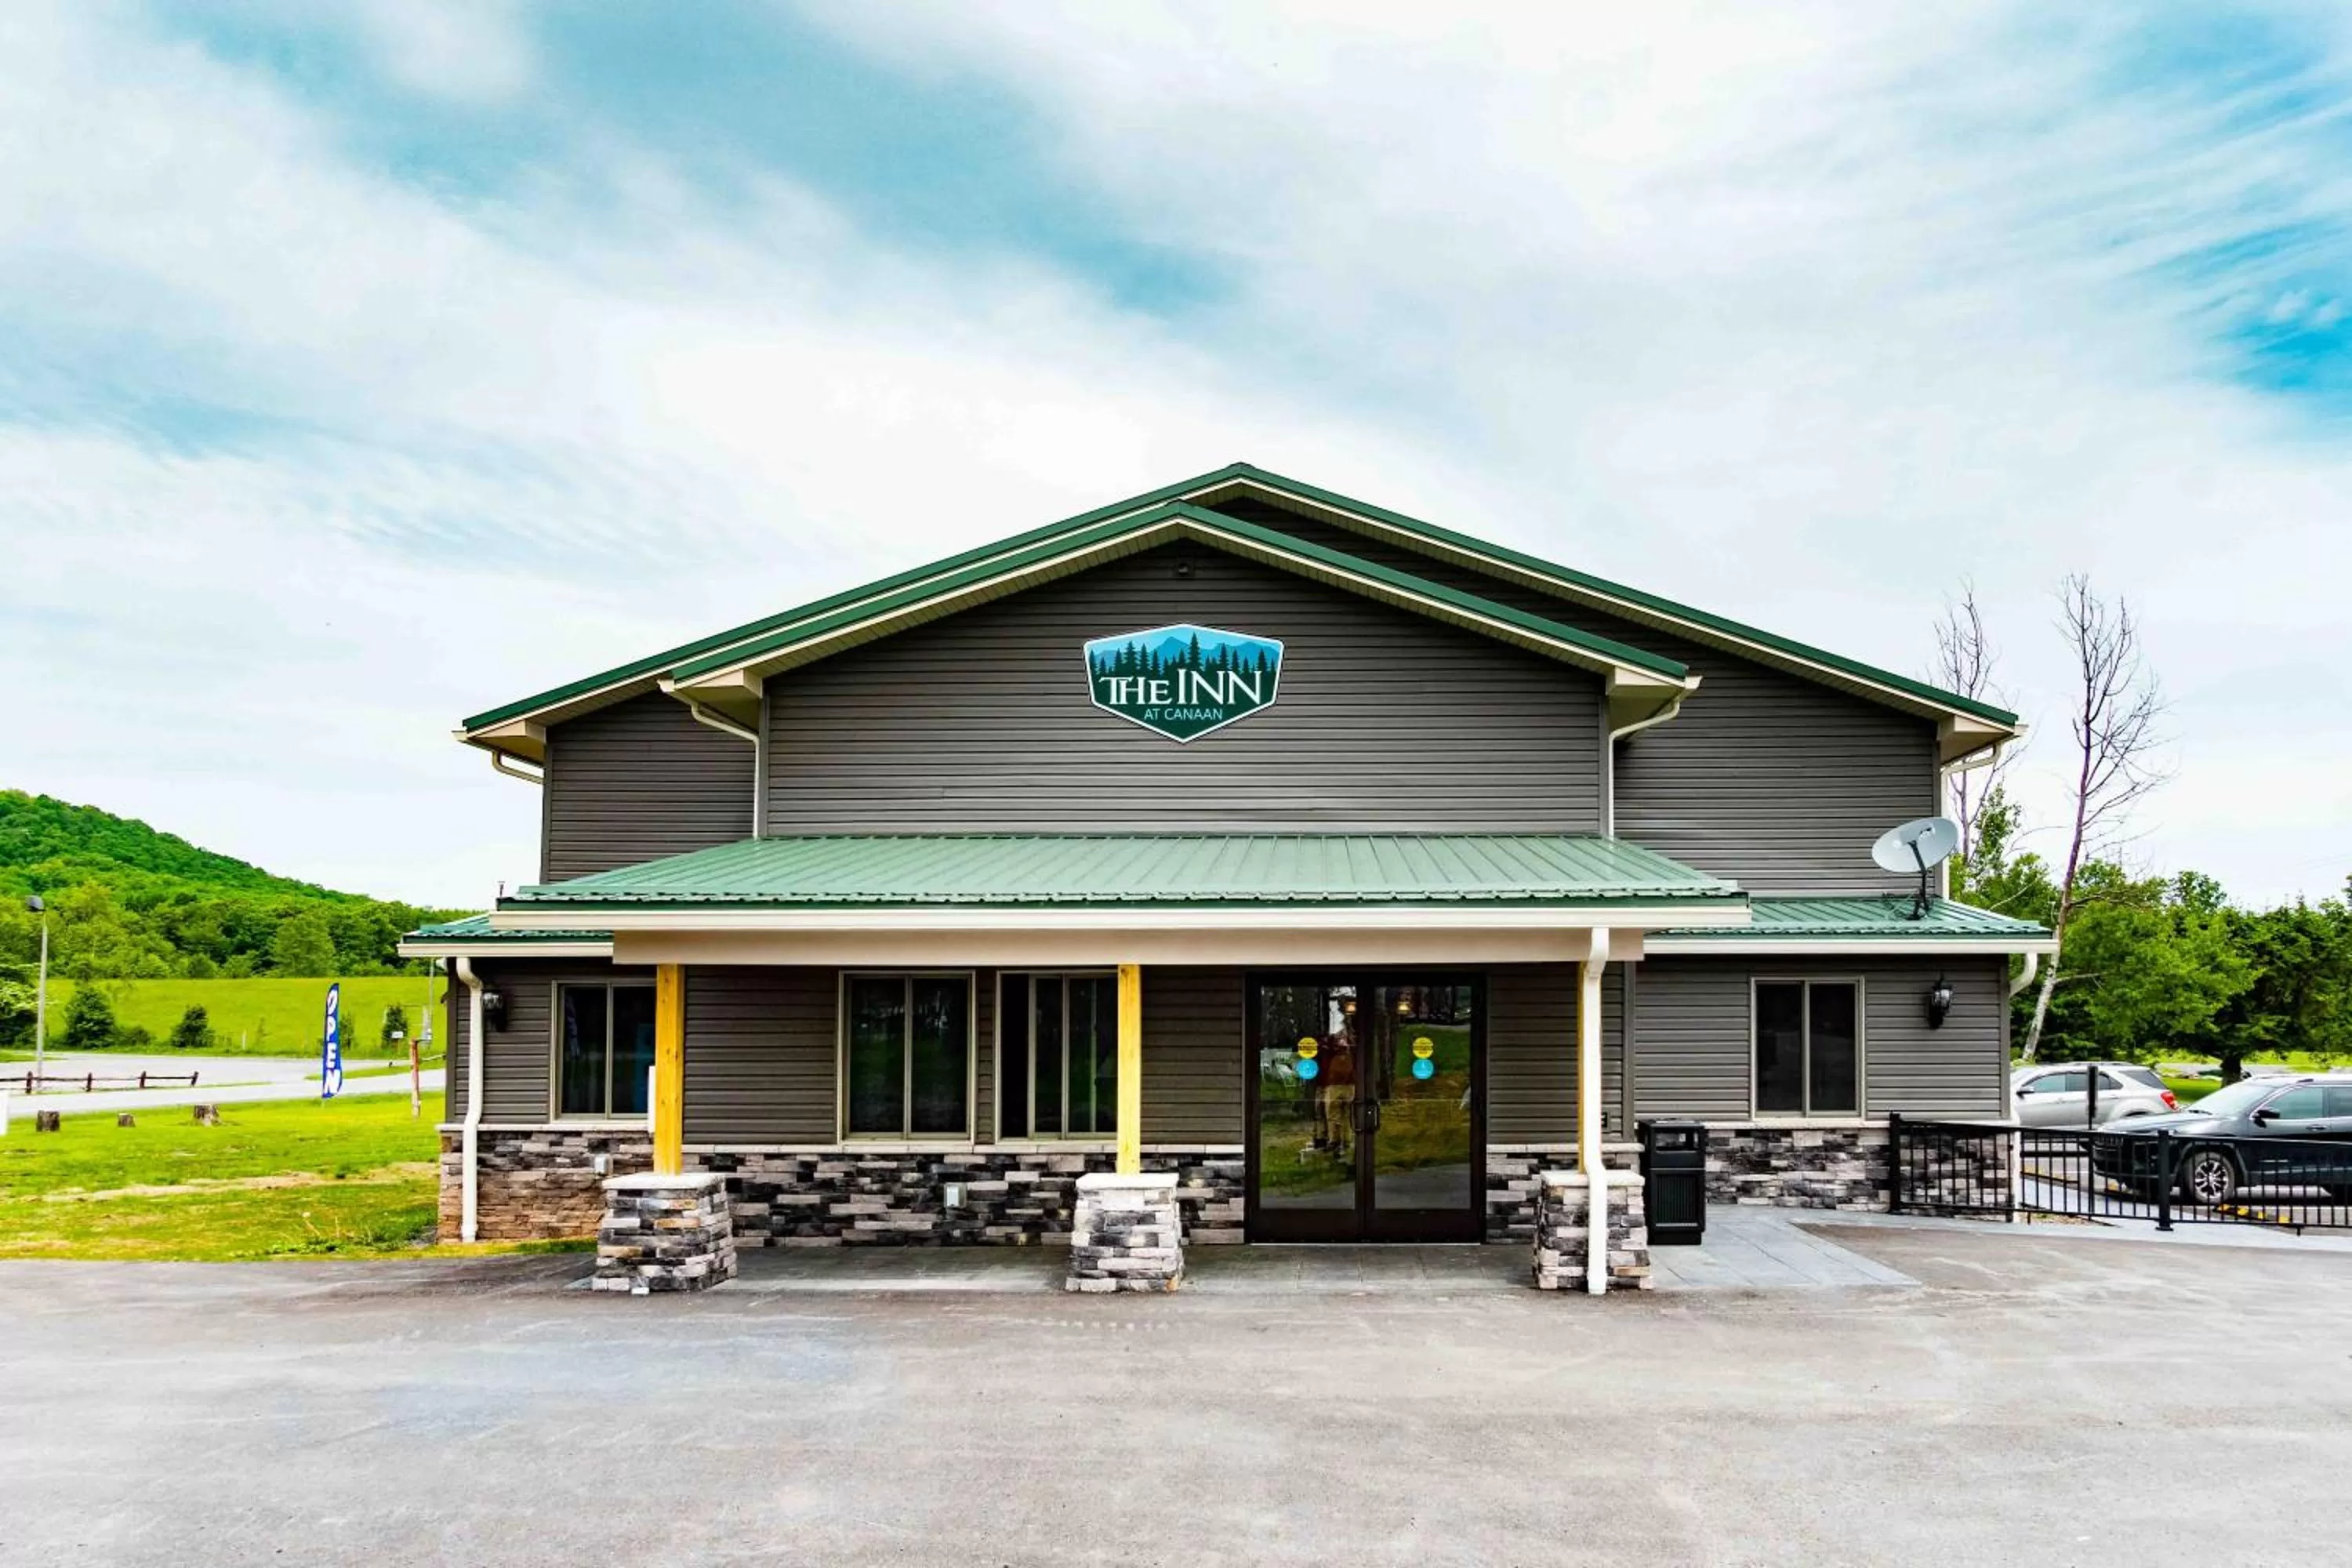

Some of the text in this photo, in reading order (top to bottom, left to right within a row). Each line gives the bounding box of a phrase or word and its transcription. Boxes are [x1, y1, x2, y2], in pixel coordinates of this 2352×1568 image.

[1098, 669, 1261, 705] THE INN
[1144, 708, 1223, 720] AT CANAAN
[324, 989, 341, 1094] OPEN
